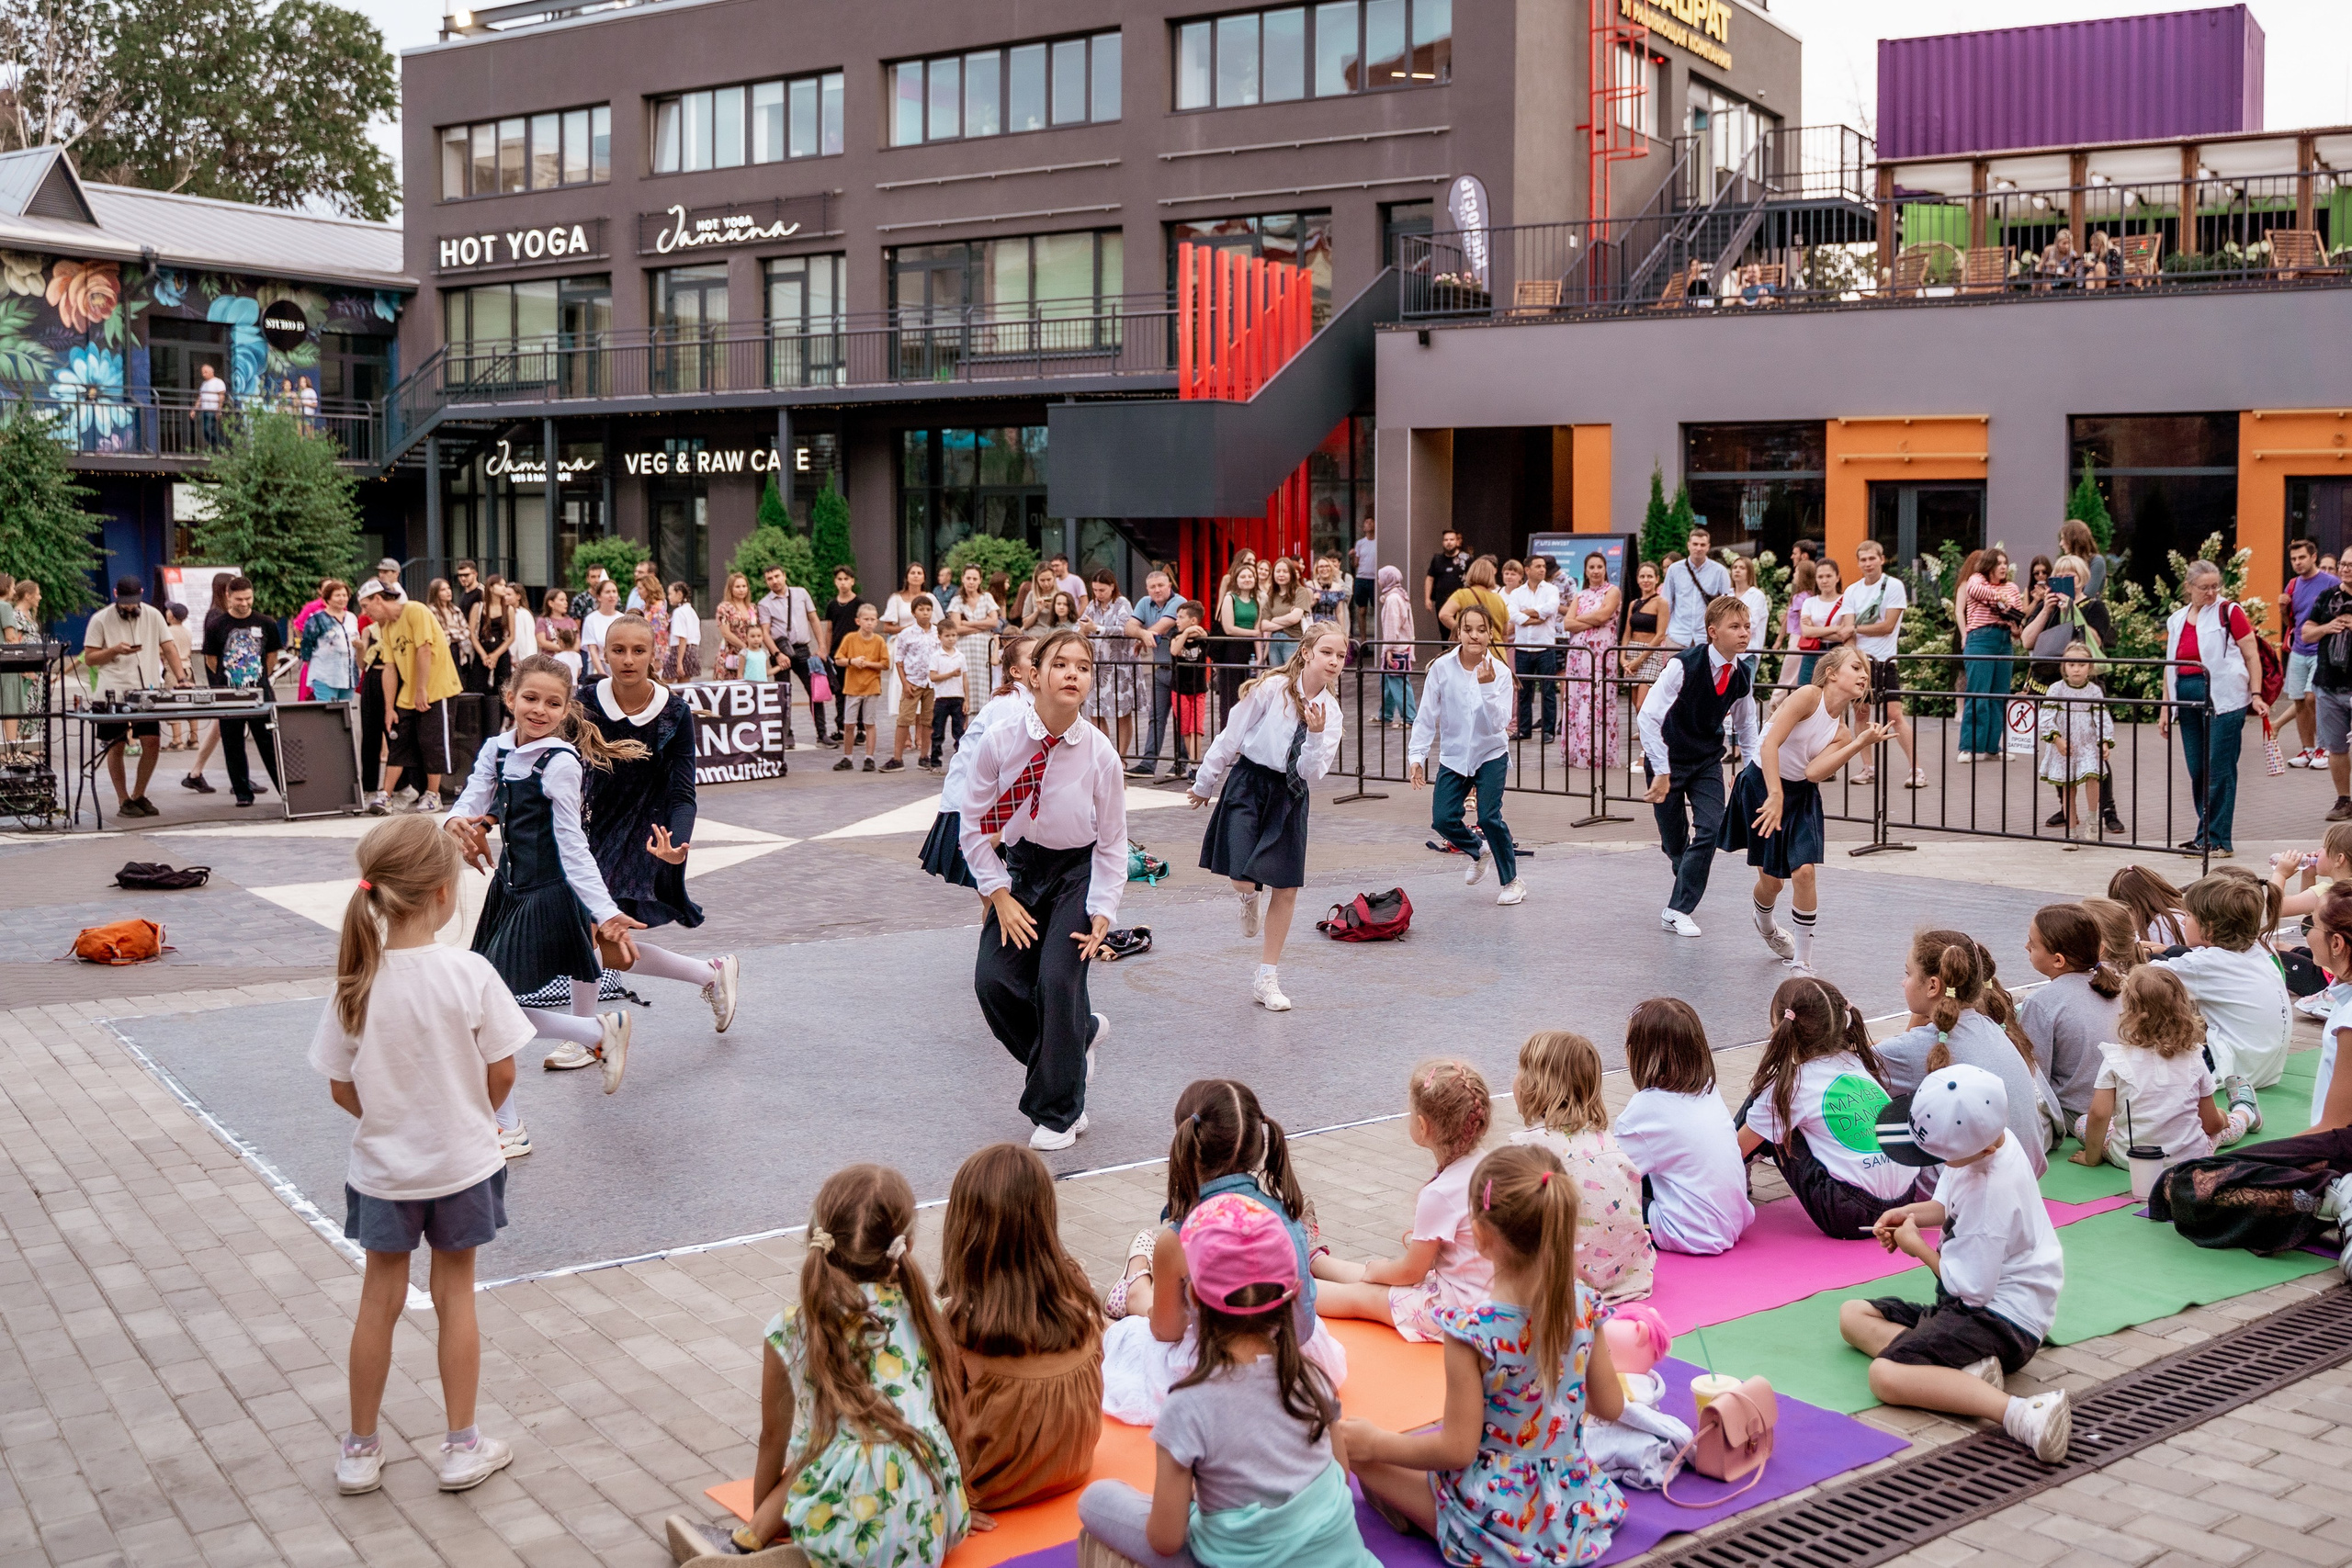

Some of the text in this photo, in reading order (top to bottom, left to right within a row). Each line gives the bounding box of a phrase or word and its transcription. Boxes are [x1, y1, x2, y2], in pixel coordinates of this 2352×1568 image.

[695, 214, 754, 231] HOT YOGA
[440, 224, 589, 267] HOT YOGA
[625, 447, 810, 475] VEG & RAW CAE
[683, 683, 782, 717] AYBE
[695, 720, 783, 757] NCE
[1828, 1088, 1883, 1114] MAYBE
[1838, 1103, 1885, 1132] DANC
[1862, 1154, 1891, 1169] SAM
